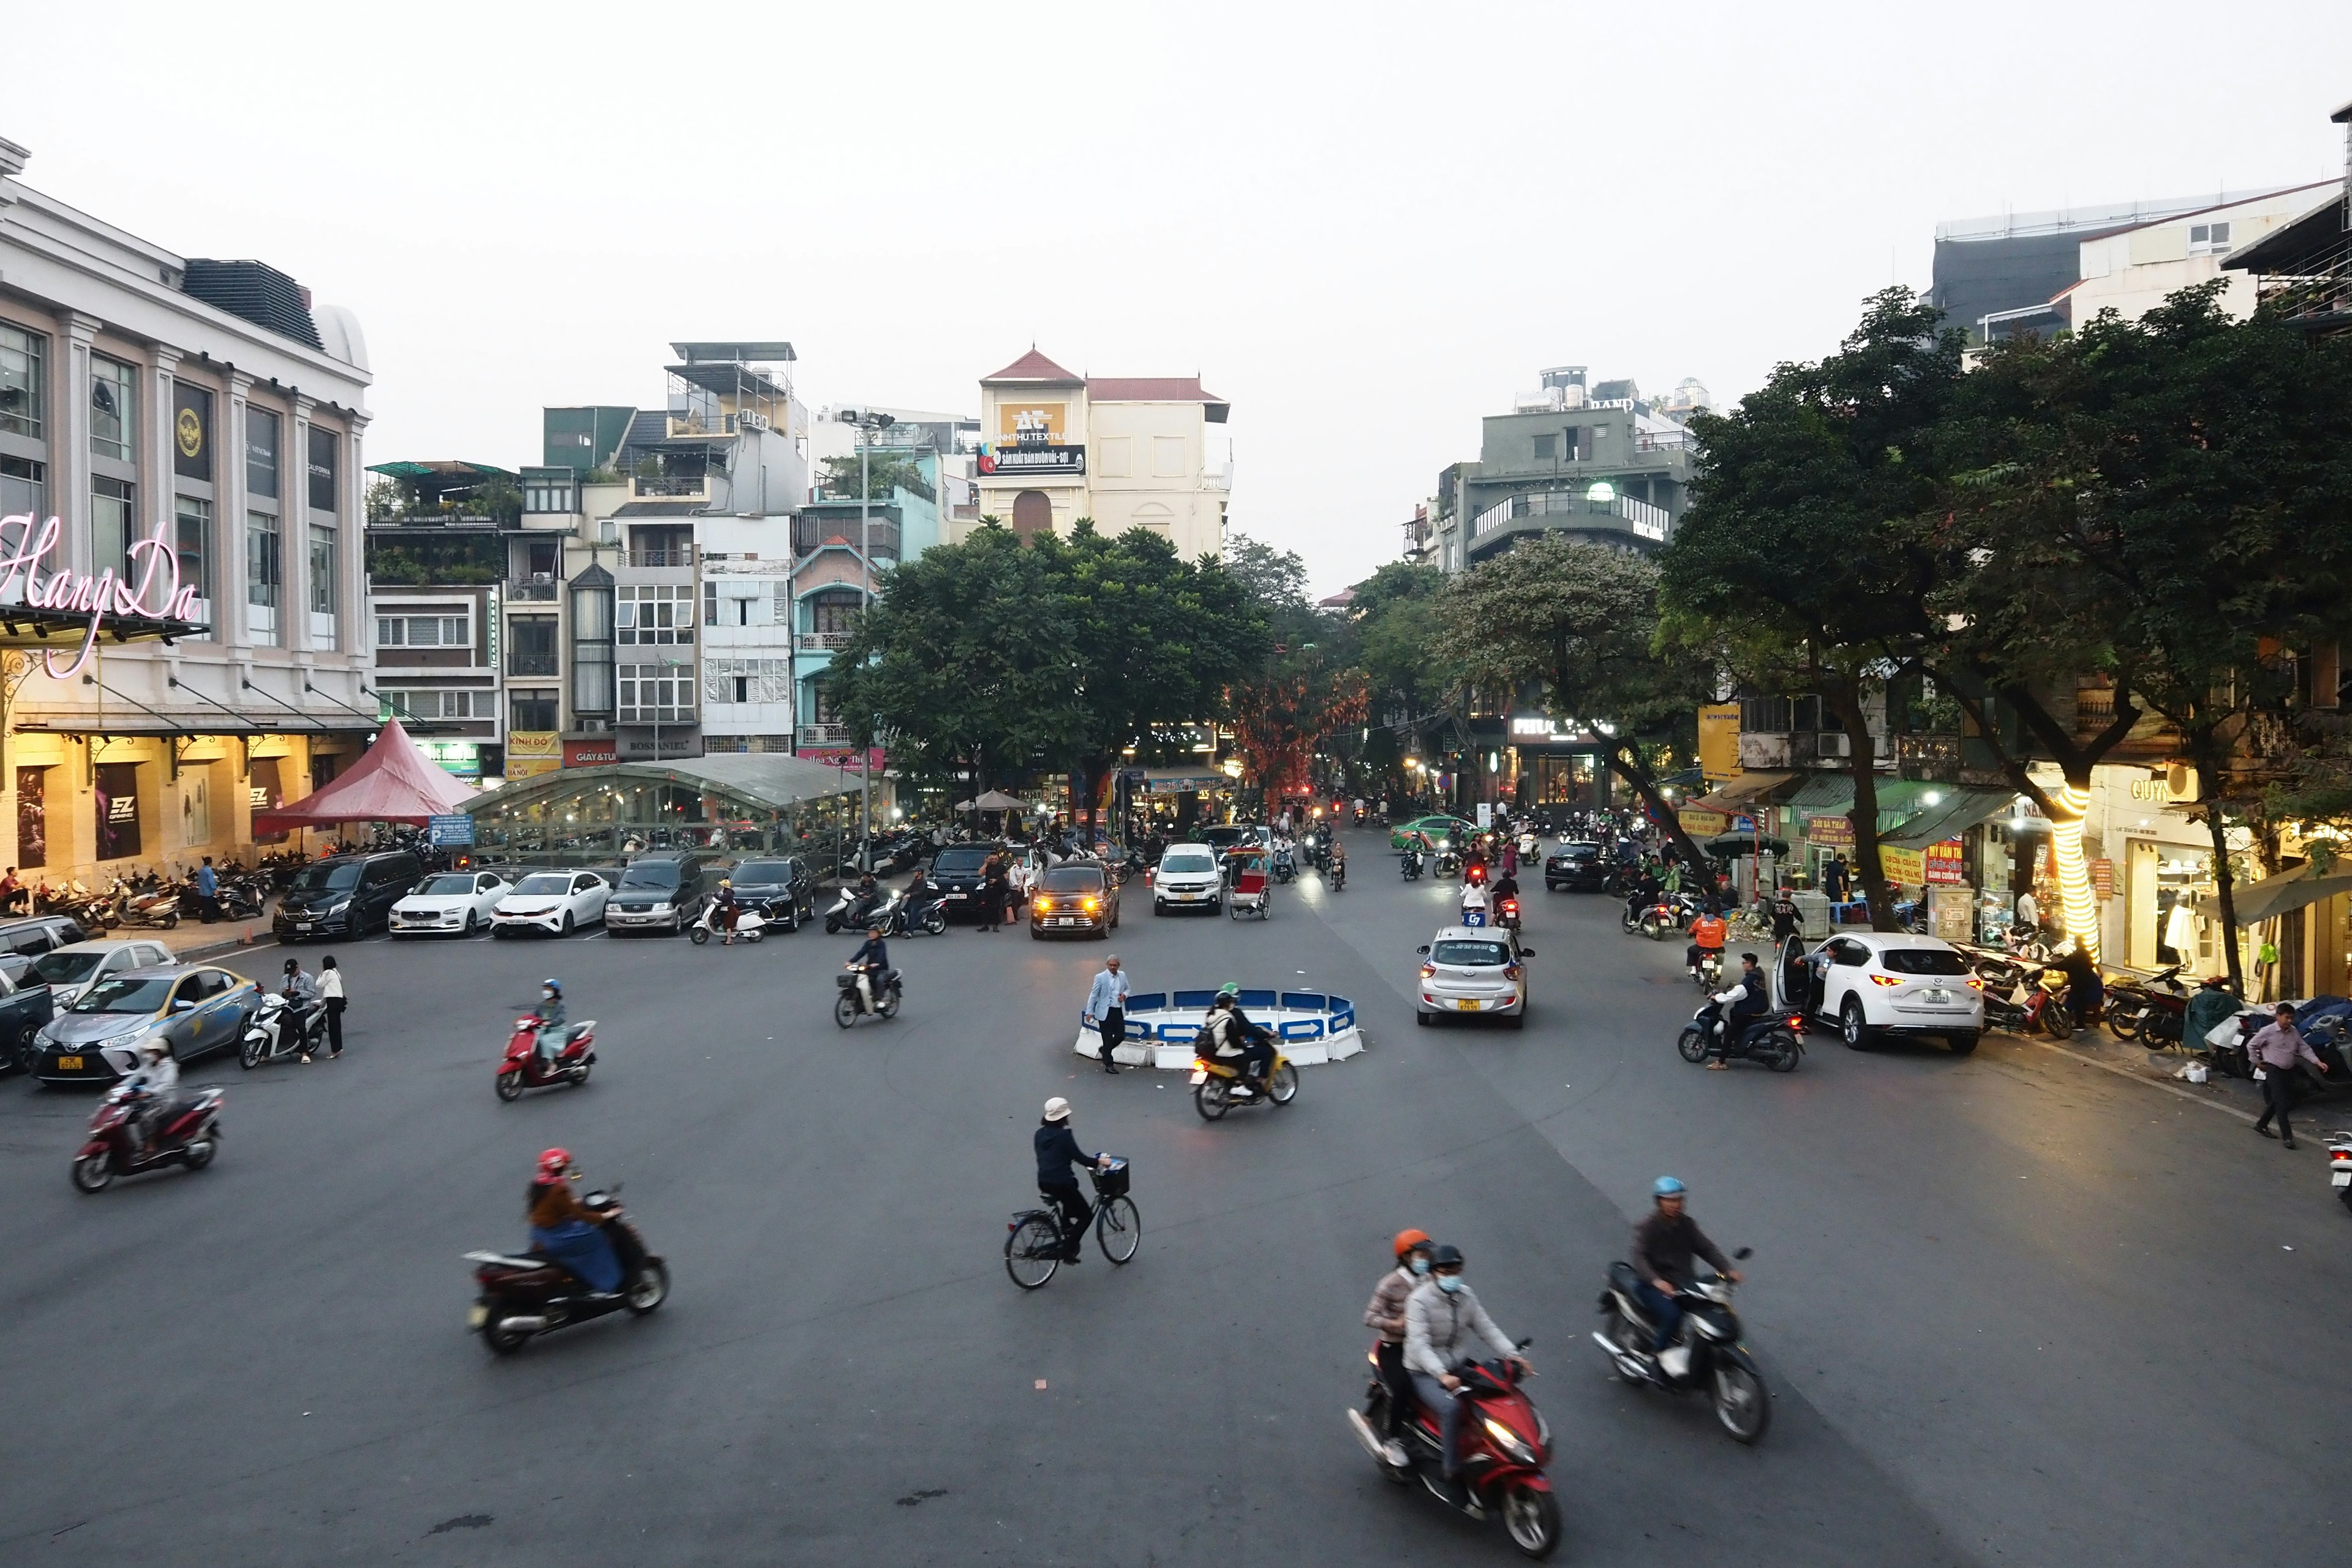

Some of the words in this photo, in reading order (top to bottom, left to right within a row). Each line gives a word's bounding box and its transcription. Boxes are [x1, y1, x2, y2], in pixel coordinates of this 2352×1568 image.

[510, 737, 532, 745] KINH
[533, 737, 548, 745] ĐÔ
[431, 830, 441, 843] P
[1469, 914, 1481, 925] G7
